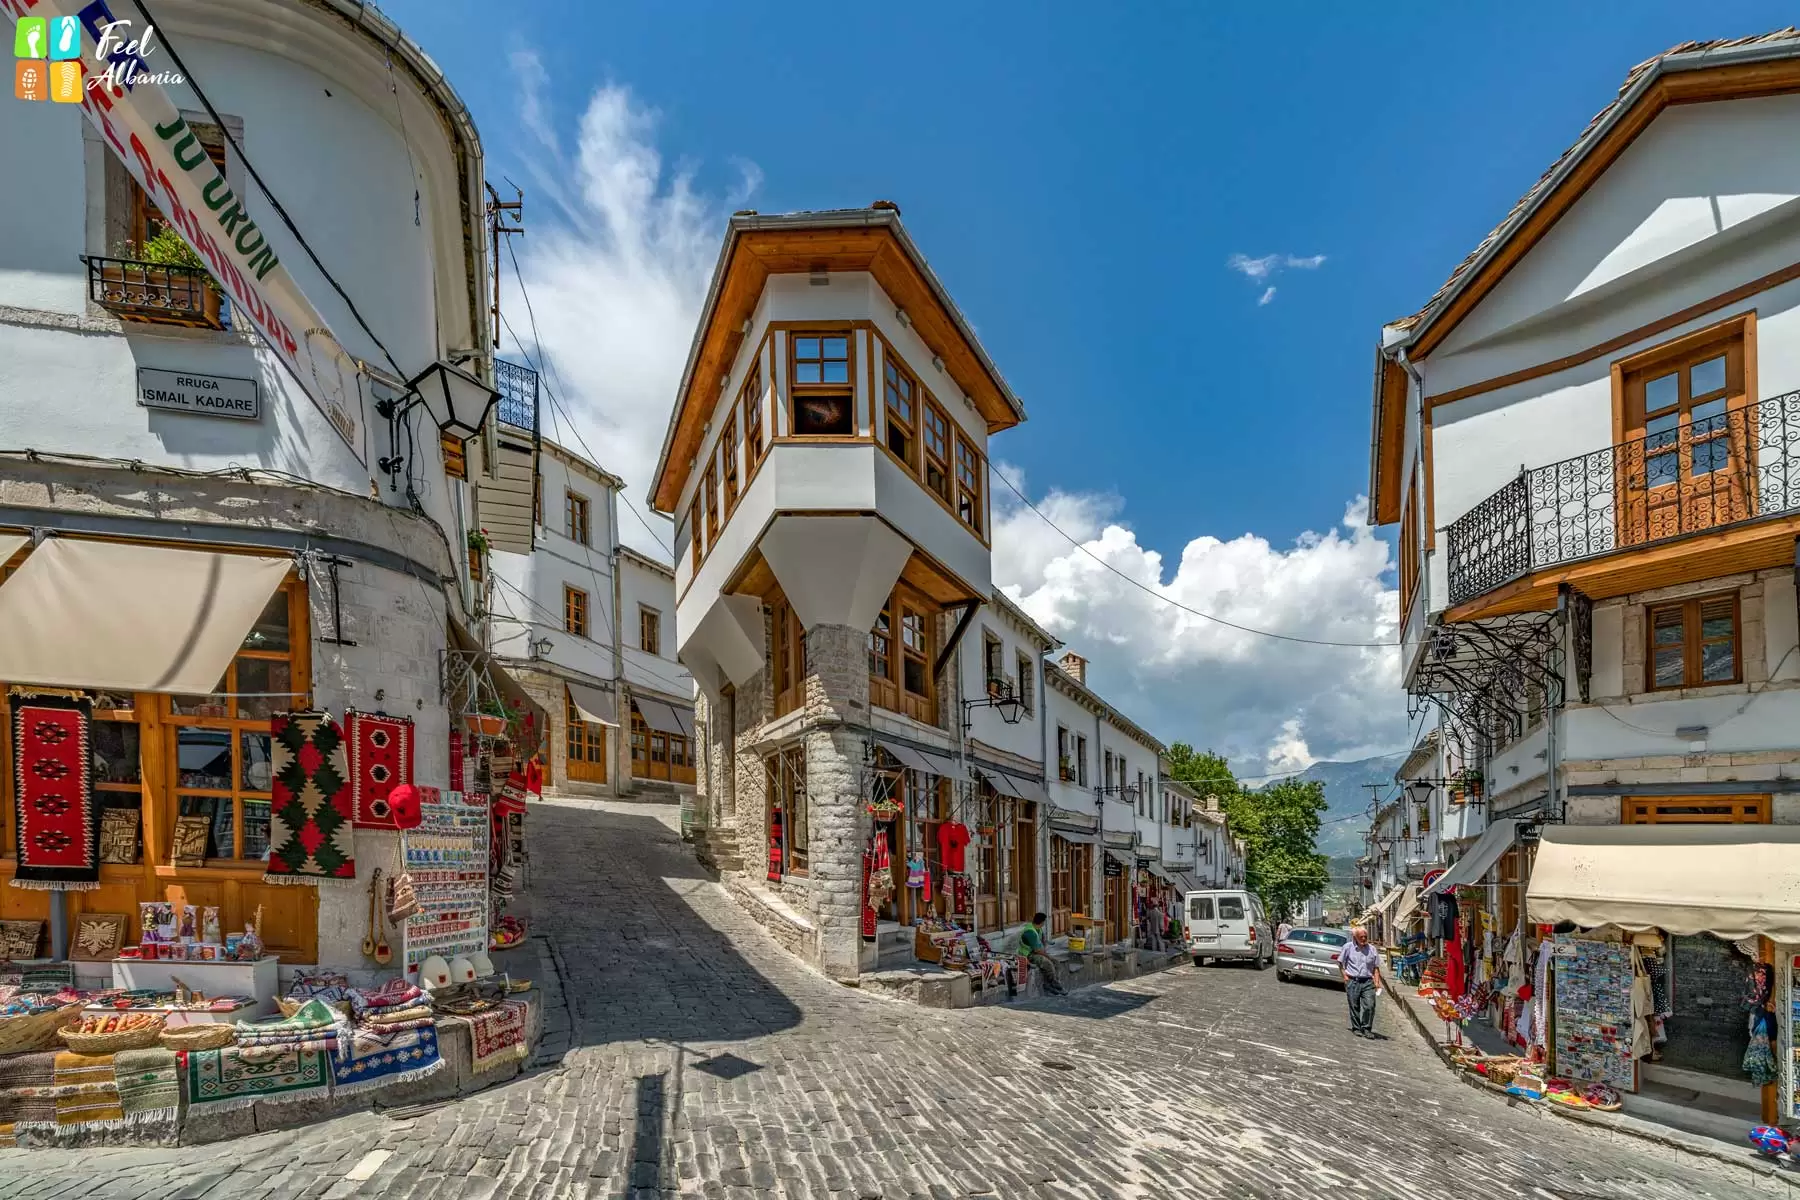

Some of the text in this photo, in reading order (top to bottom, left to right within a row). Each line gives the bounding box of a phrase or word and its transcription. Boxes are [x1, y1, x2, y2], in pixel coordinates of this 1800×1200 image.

[155, 115, 279, 281] JU URON
[176, 377, 220, 391] RRUGA
[142, 388, 253, 411] ISMAIL KADARE
